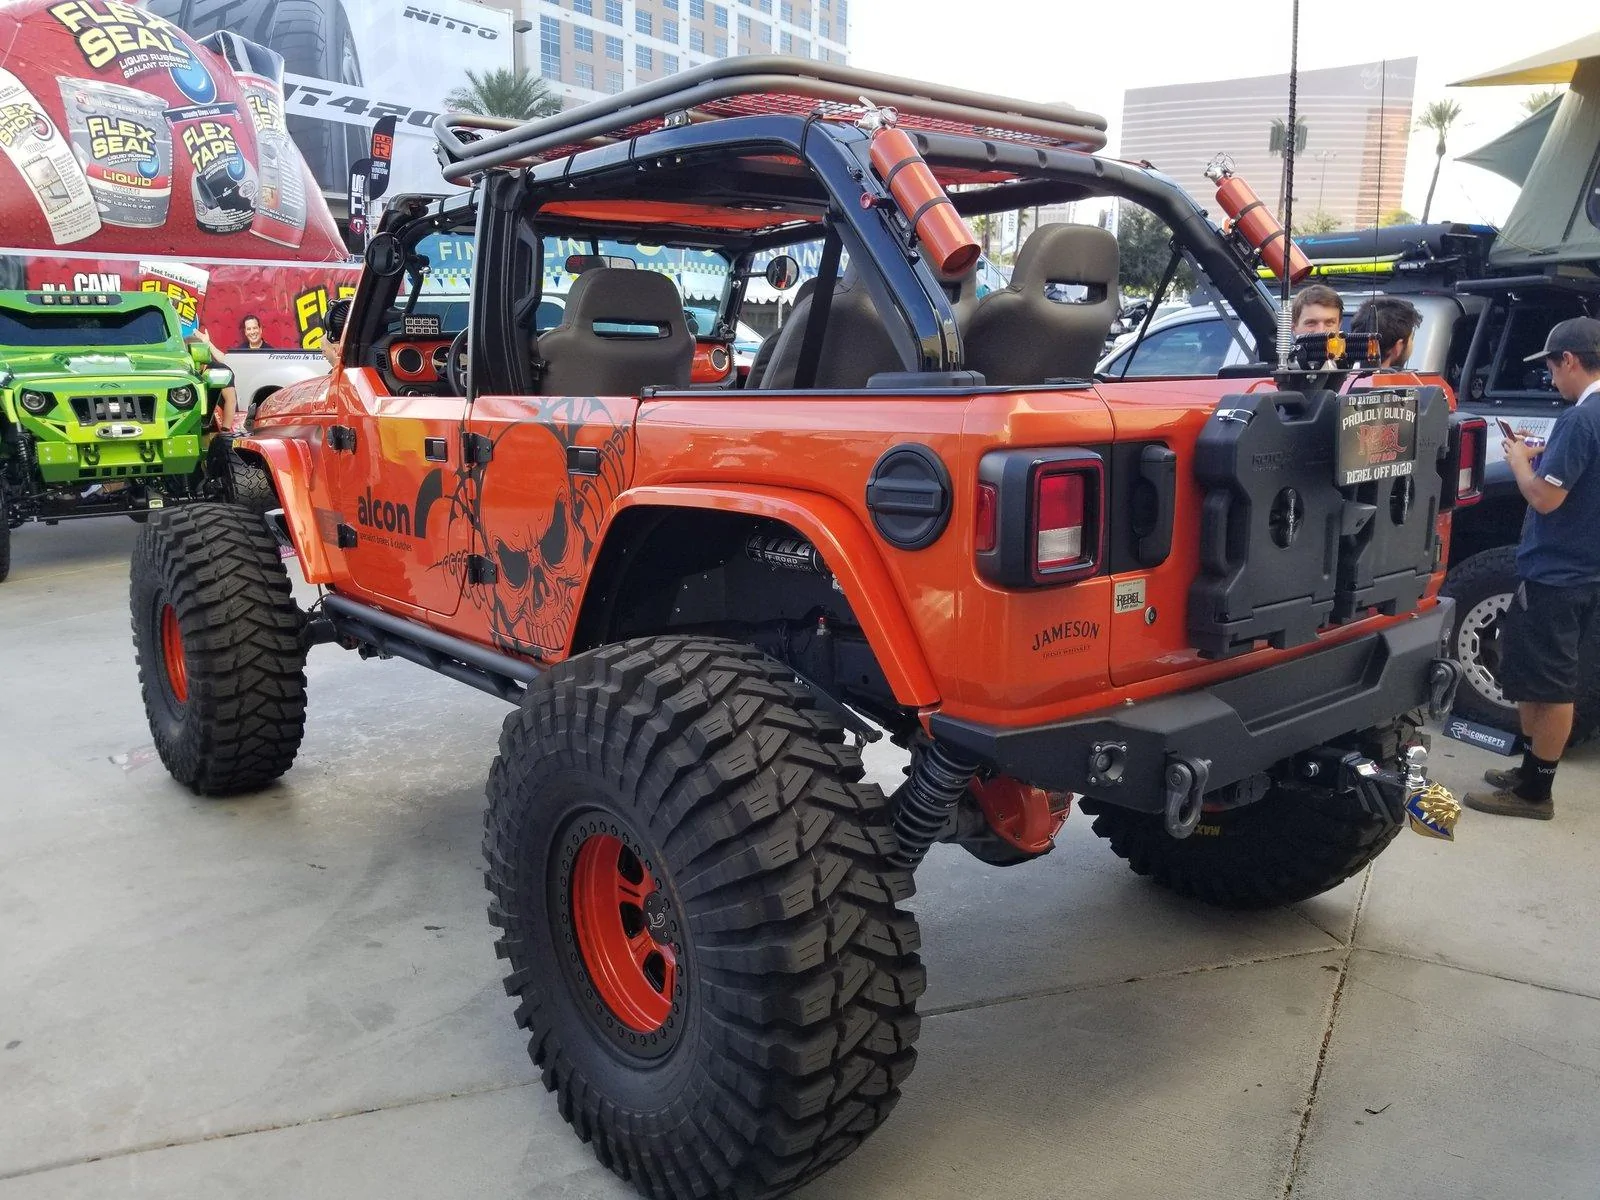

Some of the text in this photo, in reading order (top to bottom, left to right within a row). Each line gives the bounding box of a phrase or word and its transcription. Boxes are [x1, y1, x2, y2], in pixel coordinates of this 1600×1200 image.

[50, 0, 179, 39] FLEX
[403, 6, 499, 40] NITTO
[80, 27, 190, 68] SEAL
[119, 53, 149, 70] LIQUID
[123, 61, 157, 79] SEALANT
[0, 104, 35, 126] LEX
[87, 117, 156, 144] FLEX
[182, 122, 234, 154] FLEX
[92, 137, 155, 159] SEAL
[191, 140, 237, 174] TAPE
[103, 170, 152, 186] LIQUID
[1343, 407, 1417, 431] PROUDLY BUILT BY
[1346, 462, 1412, 484] REBEL OFF ROAD
[358, 486, 411, 536] alcon
[1032, 621, 1100, 651] JAMESON
[1470, 731, 1506, 748] CONCEPTS
